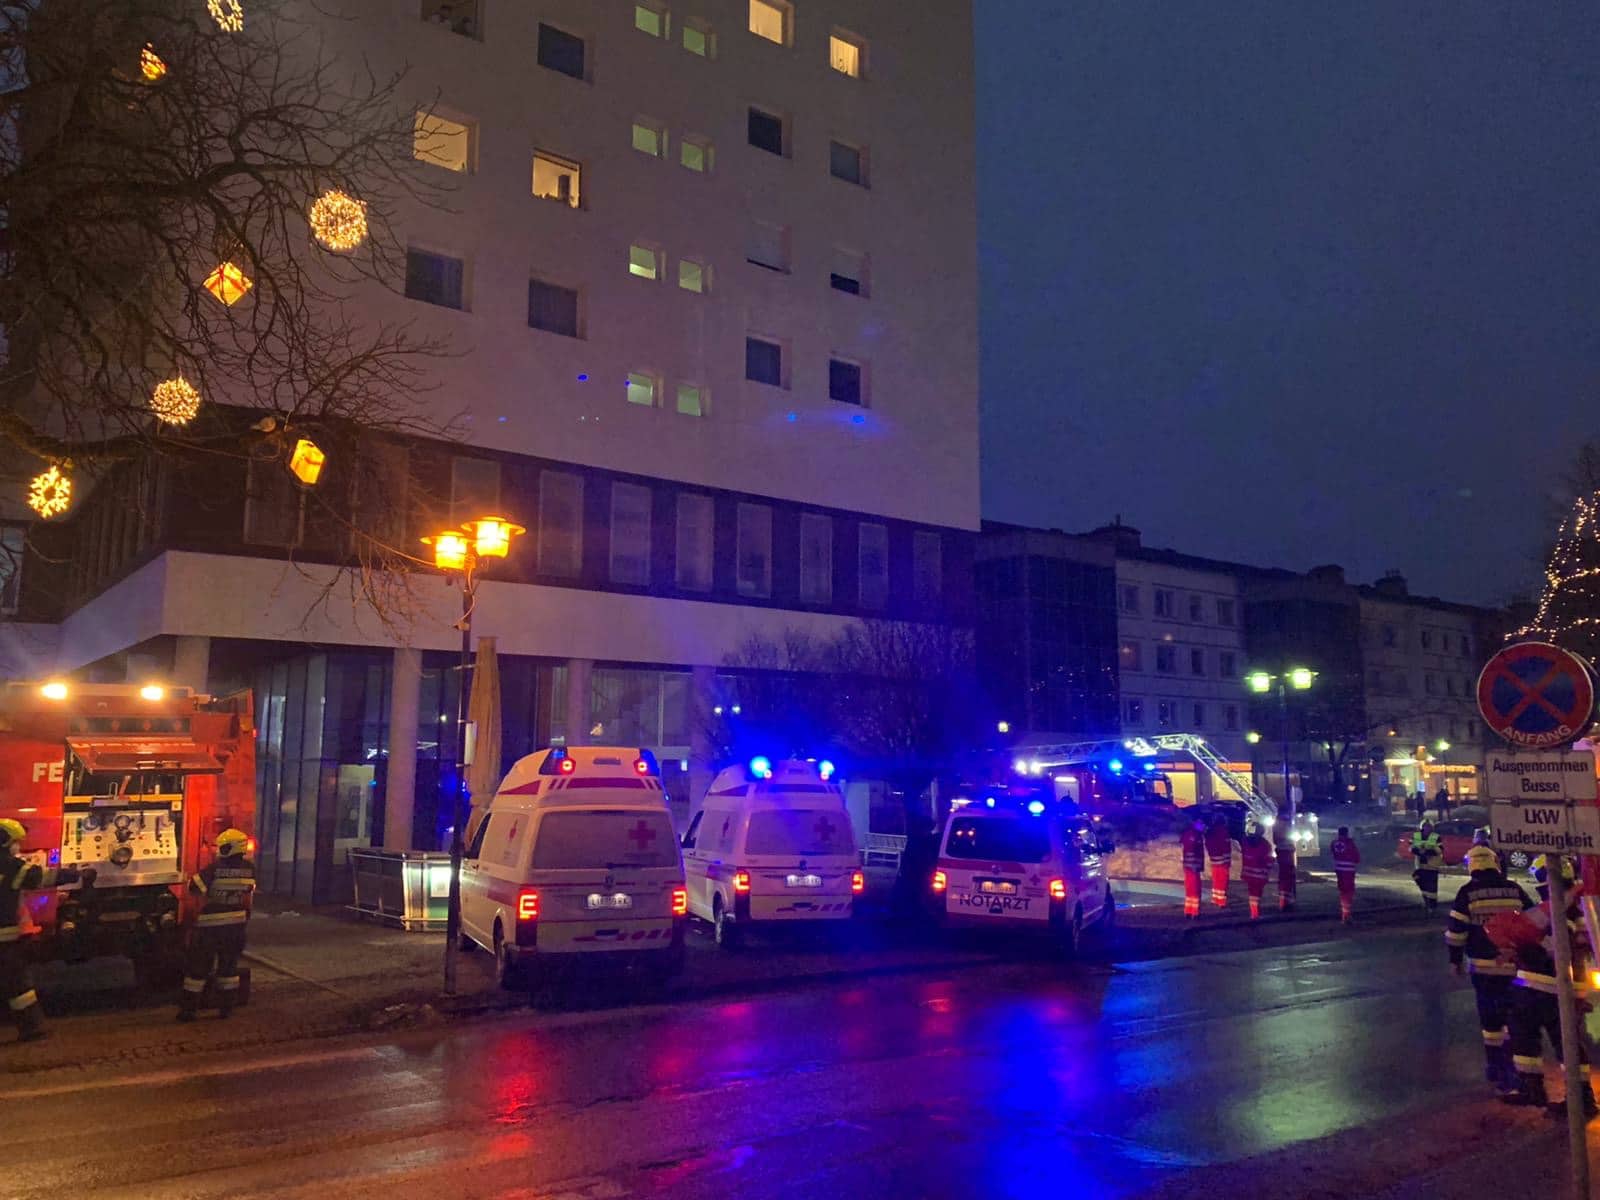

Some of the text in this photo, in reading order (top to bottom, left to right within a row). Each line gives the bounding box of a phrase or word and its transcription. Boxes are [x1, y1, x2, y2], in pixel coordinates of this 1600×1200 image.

[1502, 724, 1572, 745] ANFANG
[1493, 759, 1589, 775] Ausgenommen
[1521, 778, 1560, 793] Busse
[1524, 808, 1560, 824] LKW
[1496, 828, 1594, 849] Ladetätigkeit
[960, 893, 1031, 912] NOTARZT
